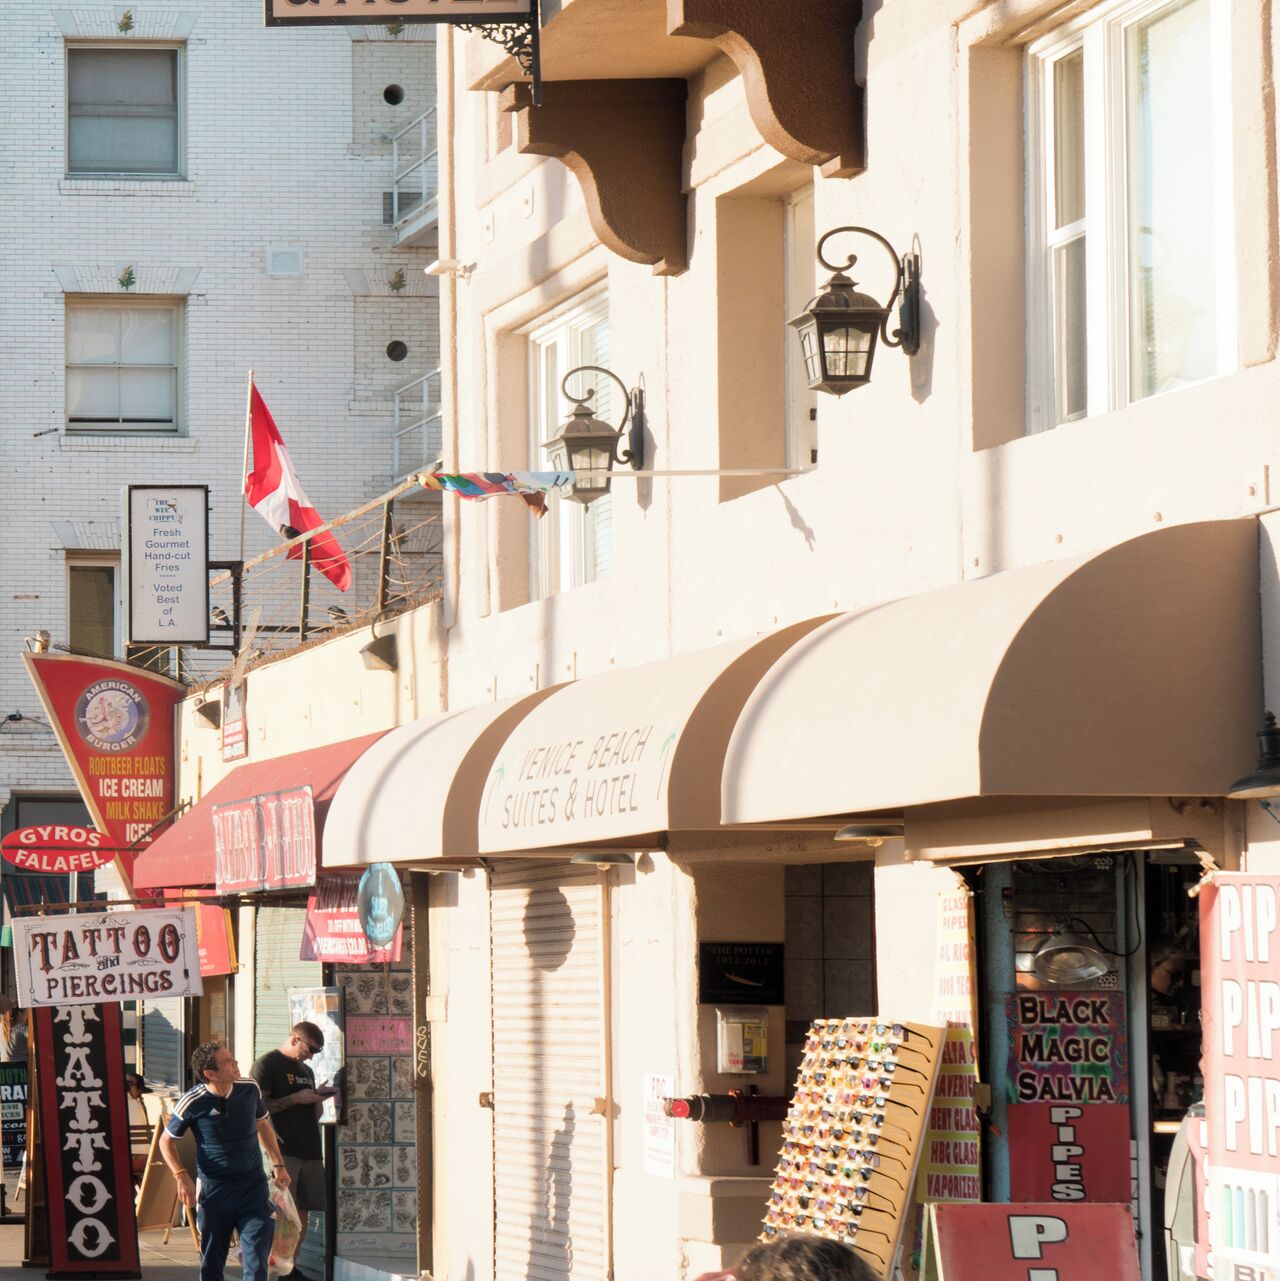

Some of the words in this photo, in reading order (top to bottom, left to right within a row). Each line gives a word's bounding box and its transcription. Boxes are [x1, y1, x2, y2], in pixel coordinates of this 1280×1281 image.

[153, 528, 181, 537] Fresh
[145, 540, 190, 549] Gourmet
[144, 552, 191, 560] Hand-cut
[155, 563, 180, 571] Fries
[154, 583, 182, 592] Voted
[157, 595, 179, 604] Best
[163, 607, 173, 615] of
[158, 619, 178, 627] L.A.
[85, 681, 142, 703] AMERICAN
[86, 734, 137, 751] BURGER
[518, 740, 584, 781] VENICE
[587, 725, 654, 770] BEACH
[89, 757, 132, 776] ROOTBEER
[134, 756, 165, 775] FLOATS
[99, 778, 118, 797] ICE
[122, 778, 164, 797] CREAM
[106, 801, 130, 820] MILK
[133, 801, 165, 820] SHAKE
[502, 786, 559, 829] SUITES
[564, 778, 578, 821] &
[584, 773, 638, 819] HOTEL
[19, 826, 101, 847] GYROS
[14, 850, 105, 871] FALAFEL
[31, 923, 181, 975] TATTOO
[97, 955, 120, 970] and
[46, 970, 173, 999] PIERCINGS
[1018, 996, 1109, 1025] BLACK
[1020, 1034, 1110, 1063] MAGIC
[1018, 1072, 1115, 1102] SALVIA
[54, 1003, 117, 1258] TATTOO
[953, 1141, 978, 1165] GLASS
[1049, 1106, 1085, 1201] PIPES
[926, 1174, 979, 1199] VAPORIZERS
